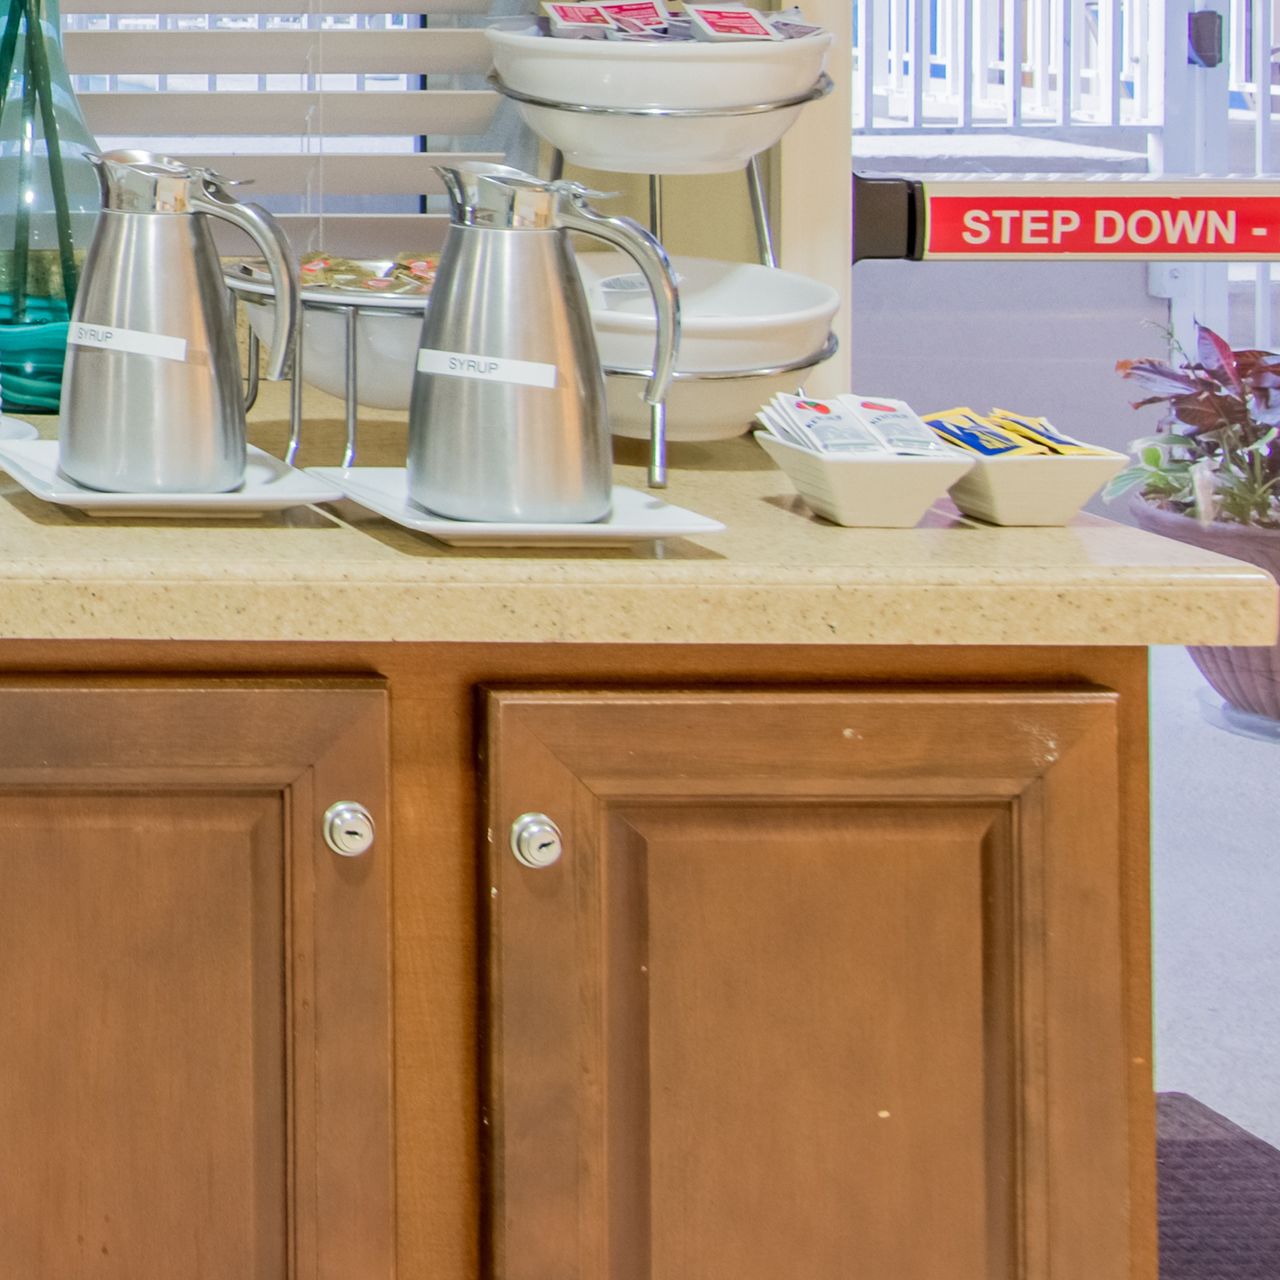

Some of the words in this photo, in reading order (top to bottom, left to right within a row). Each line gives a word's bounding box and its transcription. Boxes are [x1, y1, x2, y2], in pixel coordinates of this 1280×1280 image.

[962, 209, 1080, 245] STEP
[1094, 210, 1237, 245] DOWN
[78, 327, 114, 343] SYRUP
[448, 356, 499, 374] SYRUP
